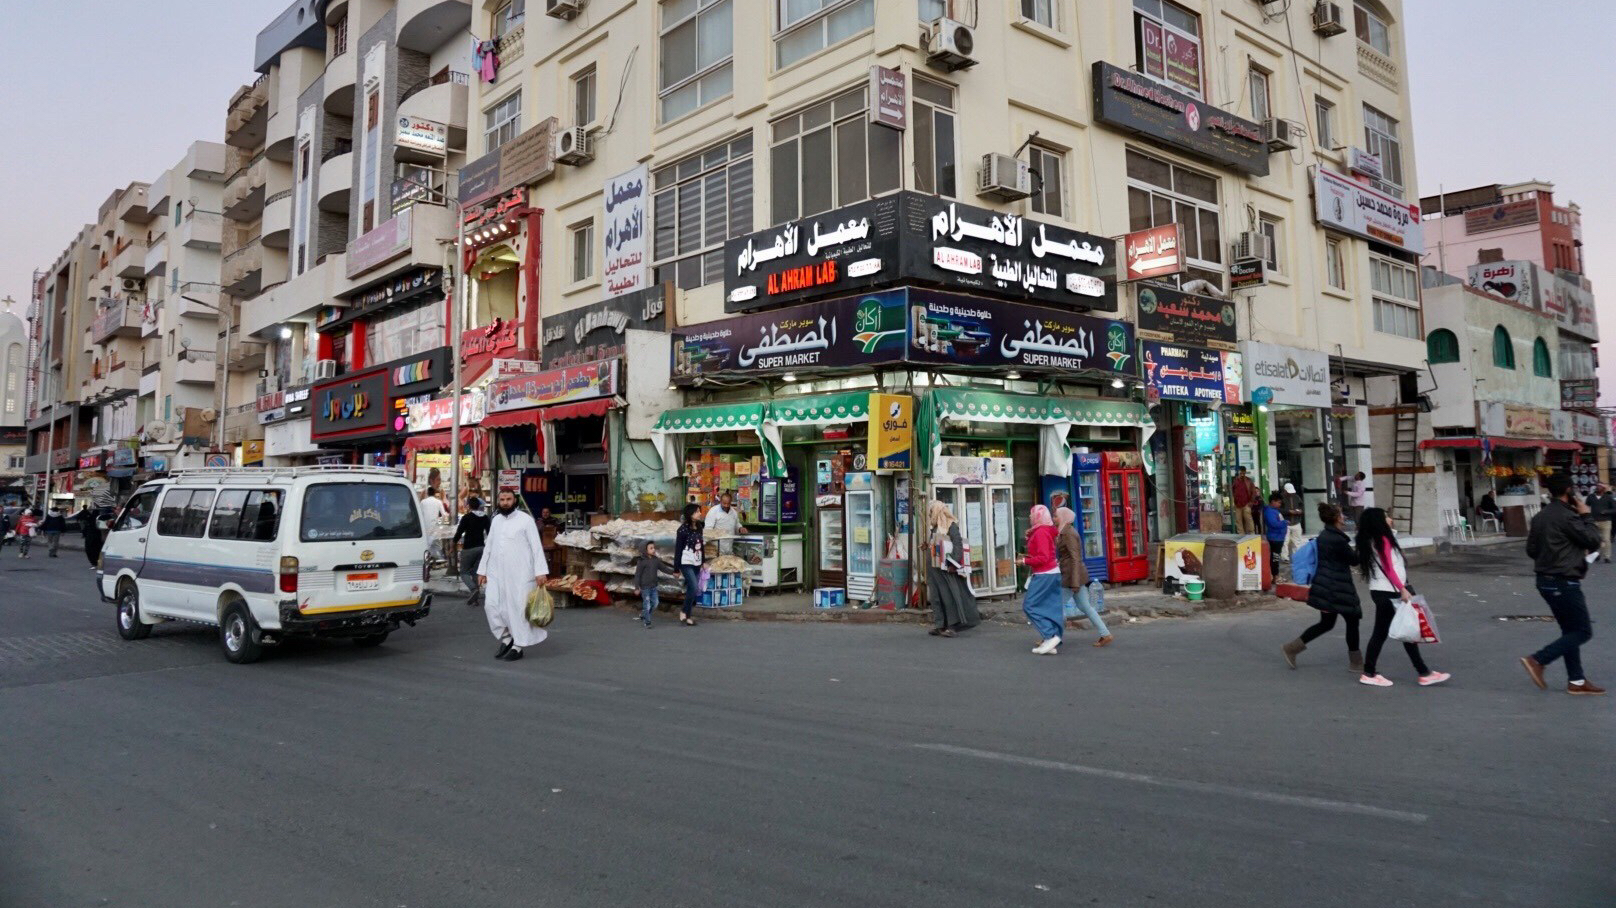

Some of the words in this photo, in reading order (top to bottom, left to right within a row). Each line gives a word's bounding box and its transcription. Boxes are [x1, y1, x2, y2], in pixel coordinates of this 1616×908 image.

[1146, 29, 1162, 49] Dr.
[606, 179, 643, 213] معمل
[1377, 202, 1392, 218] محمد
[605, 205, 643, 257] الأهرام
[932, 203, 1023, 246] الأهرام
[807, 217, 870, 257] معمل
[1031, 224, 1105, 265] معمل
[1157, 236, 1176, 254] معمل
[737, 222, 799, 276] الأهرام
[605, 252, 642, 276] للتحاليل
[936, 251, 944, 262] AL
[946, 252, 968, 267] AHRAM
[969, 257, 981, 270] LAB
[768, 273, 779, 295] AL
[781, 265, 813, 292] AHRAM
[816, 261, 837, 285] LAB
[989, 253, 1022, 288] الطبية
[1023, 265, 1058, 293] للتحاليل
[1483, 265, 1514, 279] زهرة
[608, 275, 639, 294] الطبية
[642, 297, 664, 321] فول
[929, 302, 949, 314] طحينة
[955, 306, 976, 317] طحينية
[977, 308, 992, 320] حلاوة
[779, 320, 798, 330] ماركت
[855, 306, 882, 332] أركان
[1044, 320, 1058, 332] ماركت
[543, 325, 566, 346] فلافل
[738, 315, 836, 367] المصطفى
[1000, 320, 1094, 358] المصطفى
[1107, 326, 1126, 351] أركان
[758, 355, 784, 369] SUPER
[786, 352, 821, 367] MARKET
[1023, 353, 1049, 366] SUPER
[1050, 355, 1082, 369] MARKET
[1160, 347, 1189, 358] PHARMACY
[1255, 361, 1289, 379] etisalat
[1299, 365, 1327, 384] اتصالات
[1163, 385, 1189, 396] АПТЕКА
[1194, 387, 1222, 399] APOTHEKE
[888, 460, 905, 468] 16421
